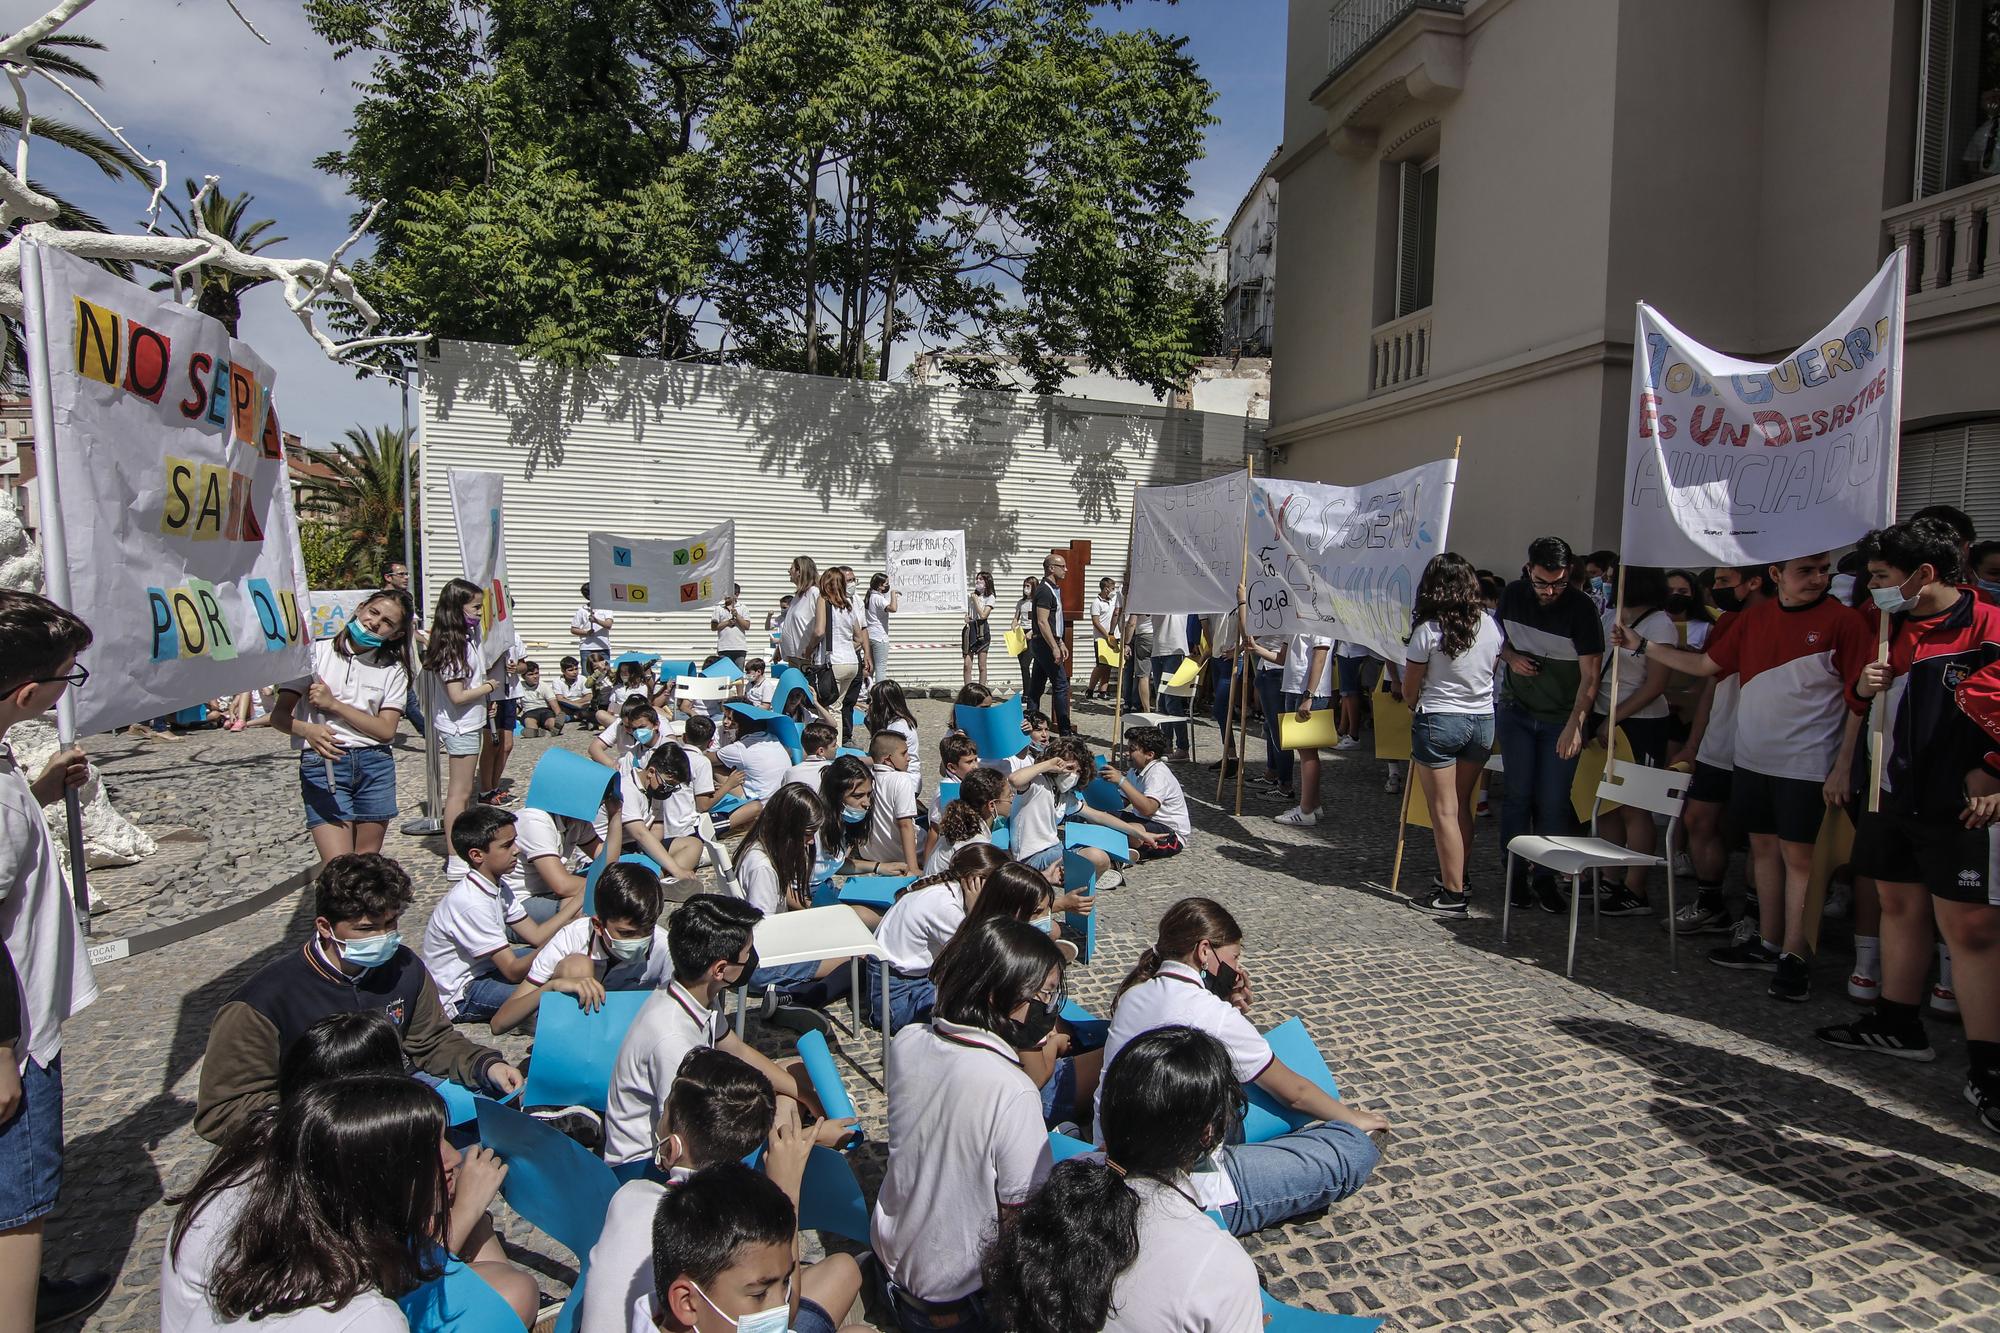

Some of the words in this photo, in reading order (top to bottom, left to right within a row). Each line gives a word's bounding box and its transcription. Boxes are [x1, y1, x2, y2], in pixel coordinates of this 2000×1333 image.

[79, 301, 169, 398] NO
[909, 538, 940, 551] GUERRA
[616, 551, 626, 563] Y
[675, 547, 704, 565] YO
[615, 588, 645, 600] LO
[1248, 580, 1289, 629] Goya
[151, 593, 231, 658] POR
[88, 945, 116, 957] TOCAR
